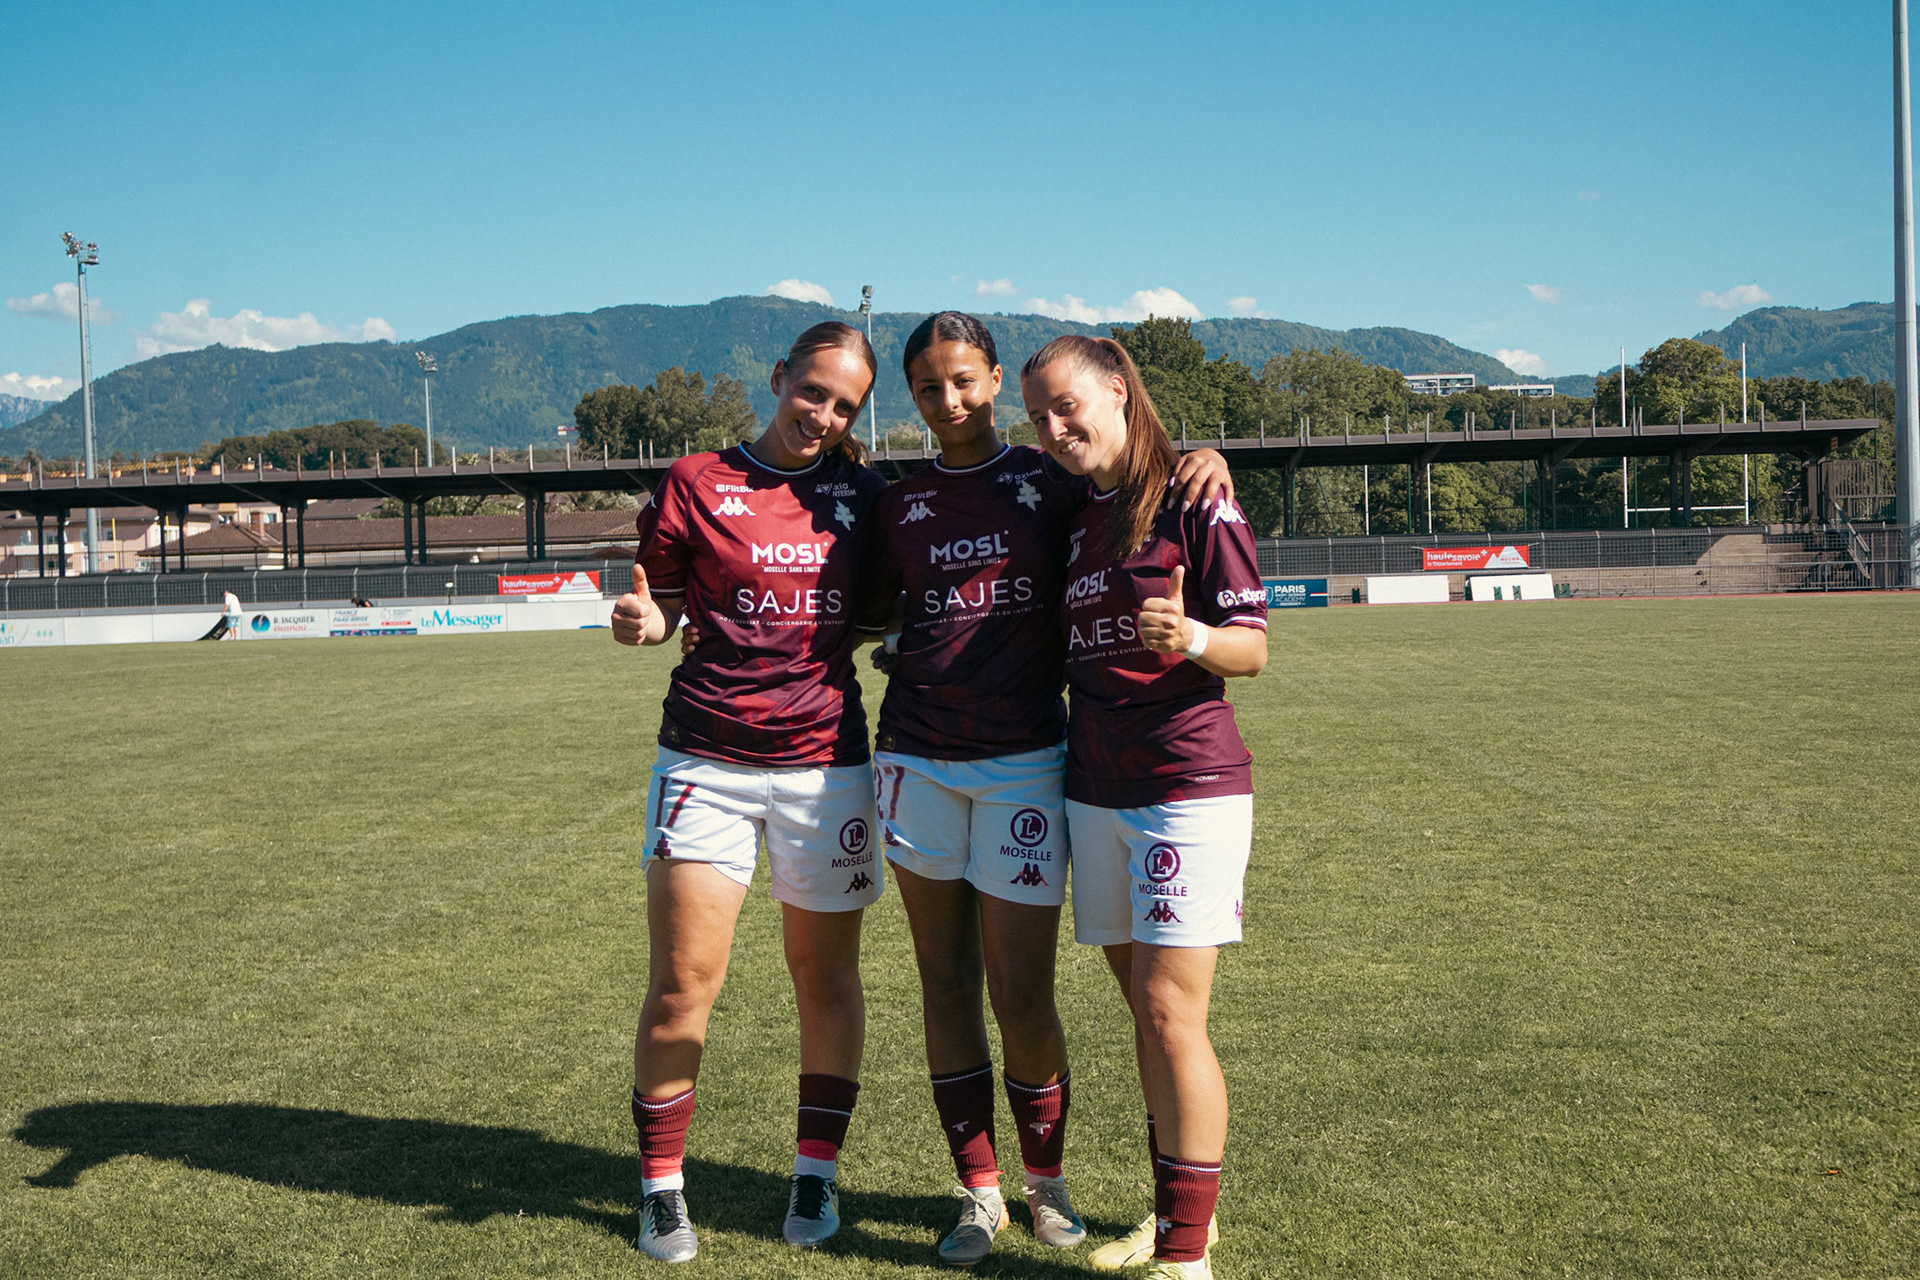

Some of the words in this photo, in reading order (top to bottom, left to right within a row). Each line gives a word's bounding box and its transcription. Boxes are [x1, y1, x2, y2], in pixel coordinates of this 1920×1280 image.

[752, 541, 829, 564] MOSL
[930, 533, 1009, 564] MOSL
[967, 559, 982, 568] SANS
[924, 576, 1033, 614] SAJES
[1274, 584, 1306, 594] PARIS
[736, 588, 842, 614] SAJES
[433, 609, 503, 630] Messager
[1069, 616, 1136, 650] AJES
[831, 851, 873, 868] MOSELLE
[1000, 844, 1052, 862] MOSELLE
[1138, 883, 1188, 897] MOSELLE
